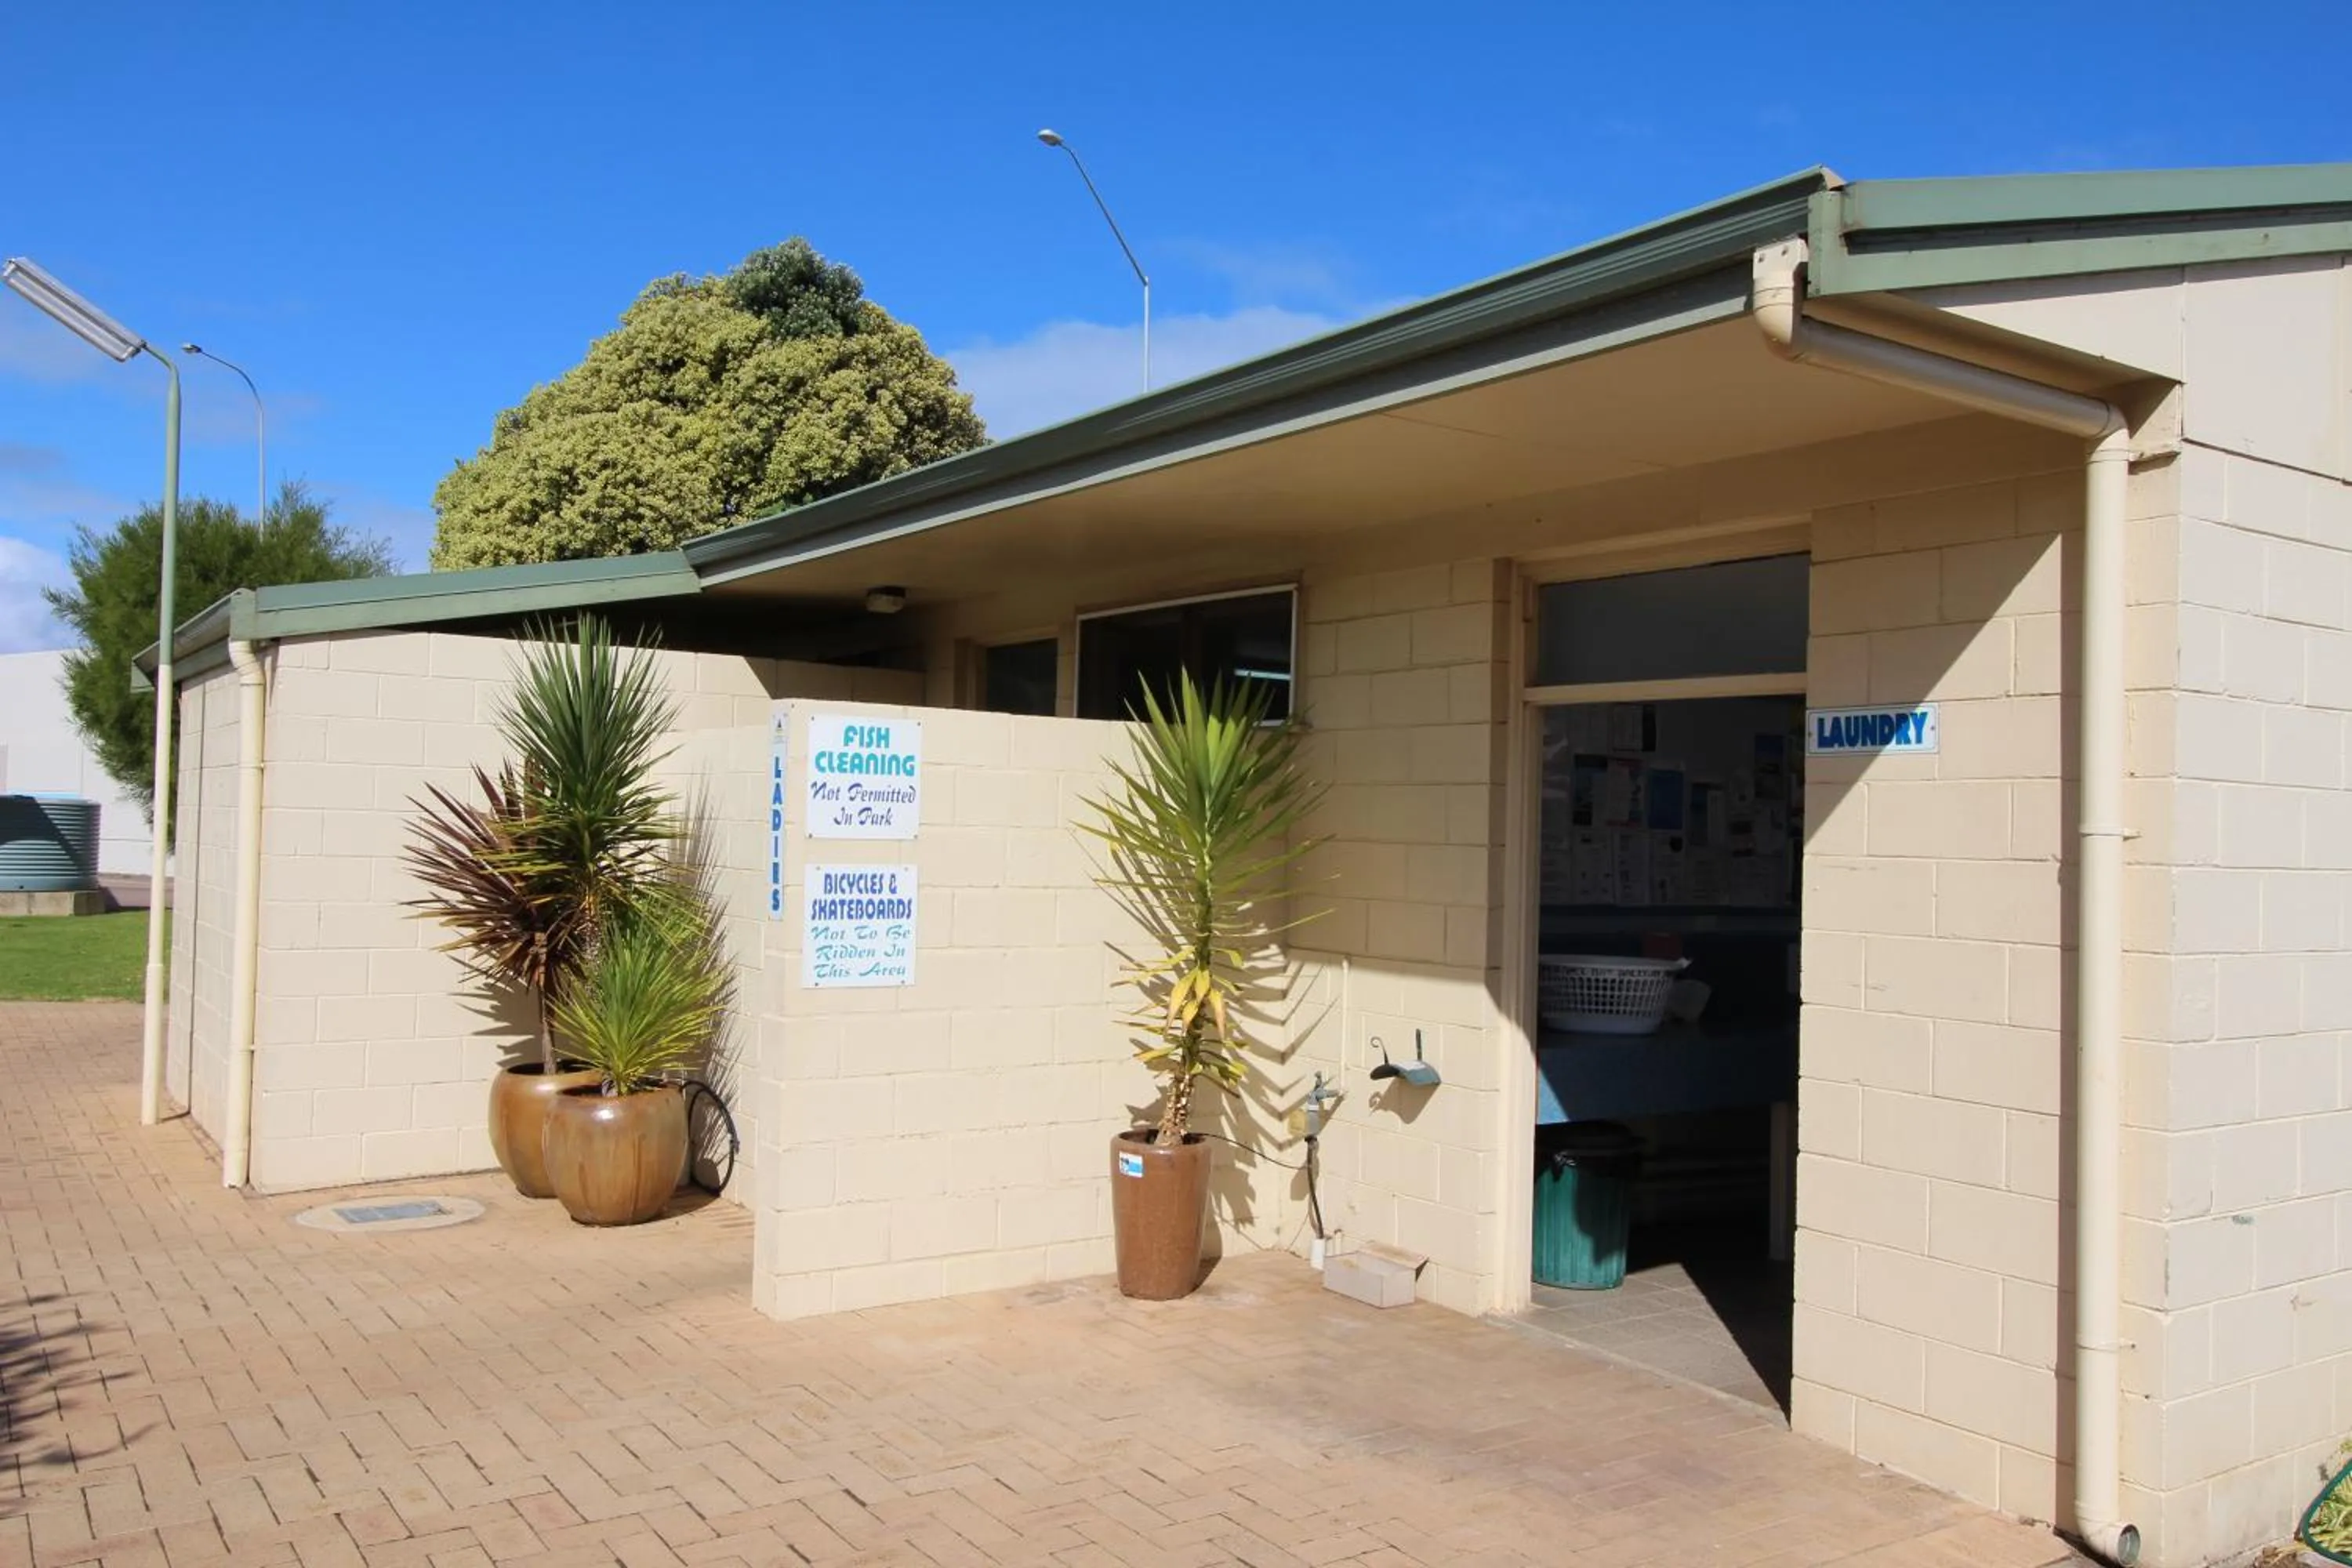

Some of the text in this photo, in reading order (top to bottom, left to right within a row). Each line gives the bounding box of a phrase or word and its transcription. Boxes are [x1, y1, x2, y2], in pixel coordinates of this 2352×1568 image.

[843, 725, 890, 749] FISH
[1817, 711, 1928, 748] LAUNDRY
[815, 750, 916, 777] CLEANING
[811, 780, 916, 804] Not Permitted
[833, 806, 892, 826] In Park
[771, 757, 782, 912] LADIES
[824, 873, 898, 895] BICYCLES &
[811, 897, 913, 920] SKATEBOARDS
[811, 924, 911, 940] Not To Be
[815, 943, 906, 961] Ridden In
[814, 962, 906, 978] This Area
